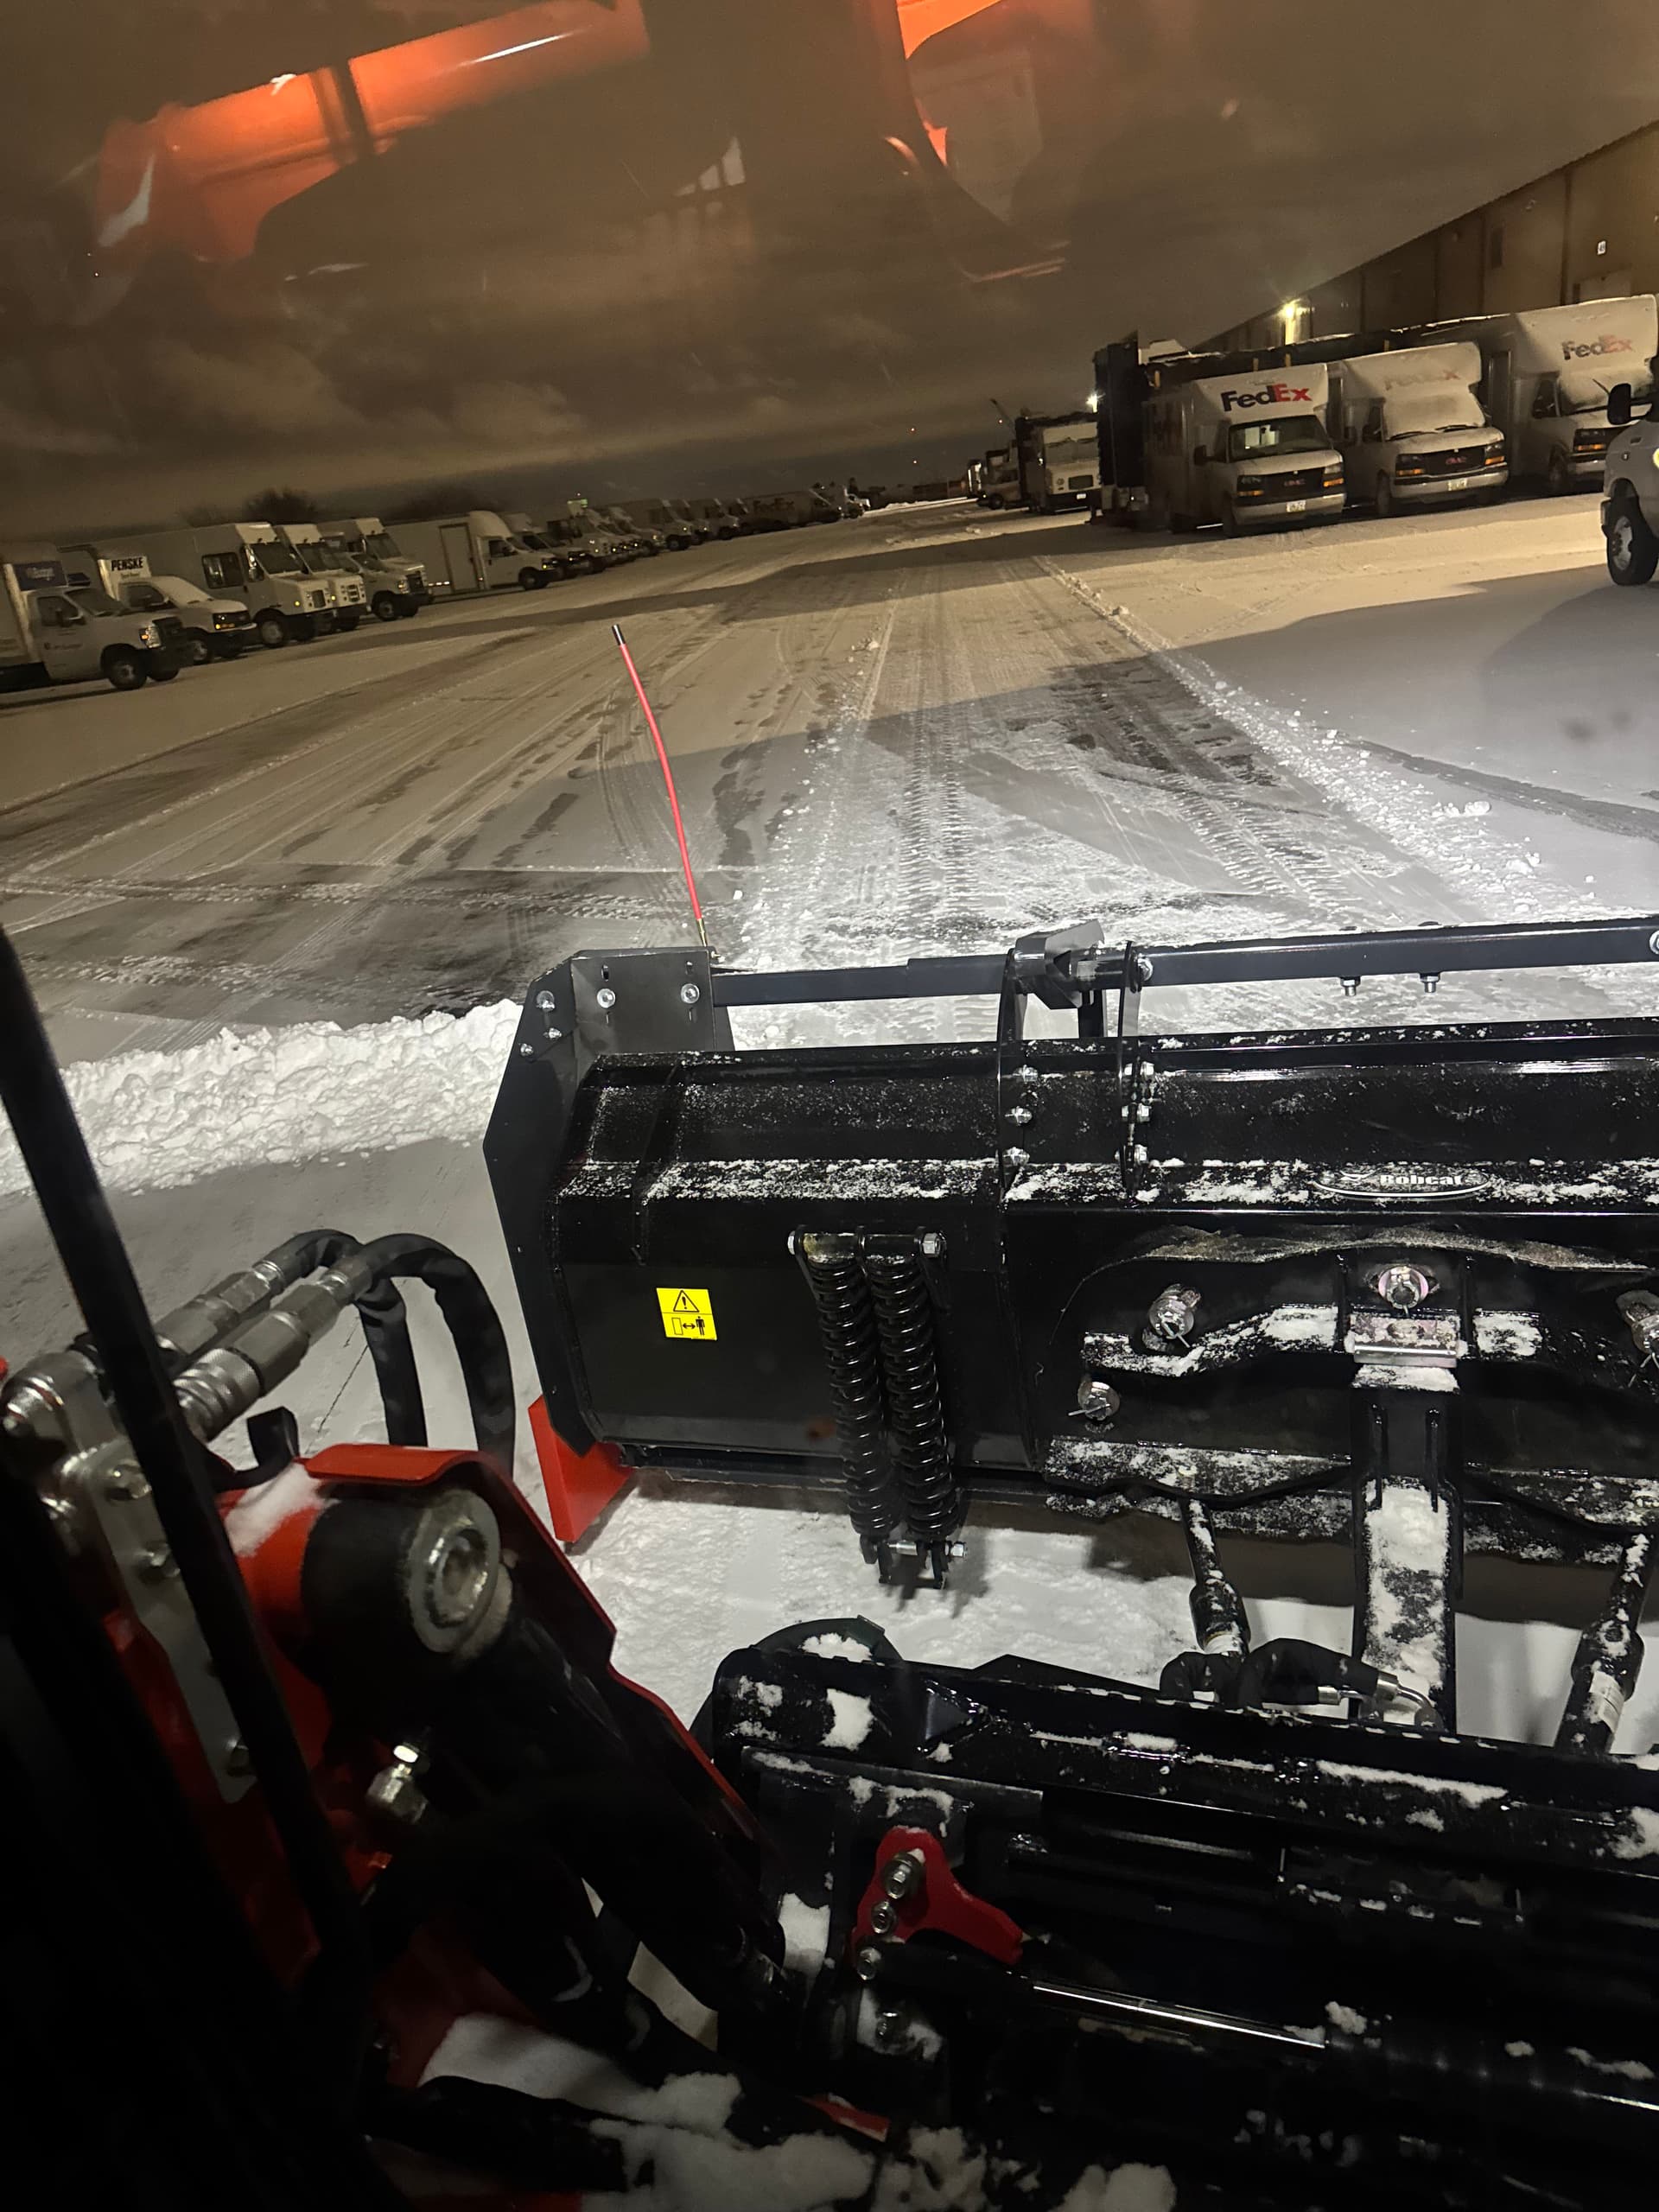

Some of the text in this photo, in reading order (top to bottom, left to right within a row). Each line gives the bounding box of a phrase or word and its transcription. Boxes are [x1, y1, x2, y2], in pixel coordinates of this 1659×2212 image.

[1561, 334, 1632, 360] FedEx
[1384, 369, 1461, 391] Fedx
[1221, 384, 1313, 411] FedEx
[111, 557, 143, 571] PENSKE
[1380, 1174, 1464, 1185] Bobcat
